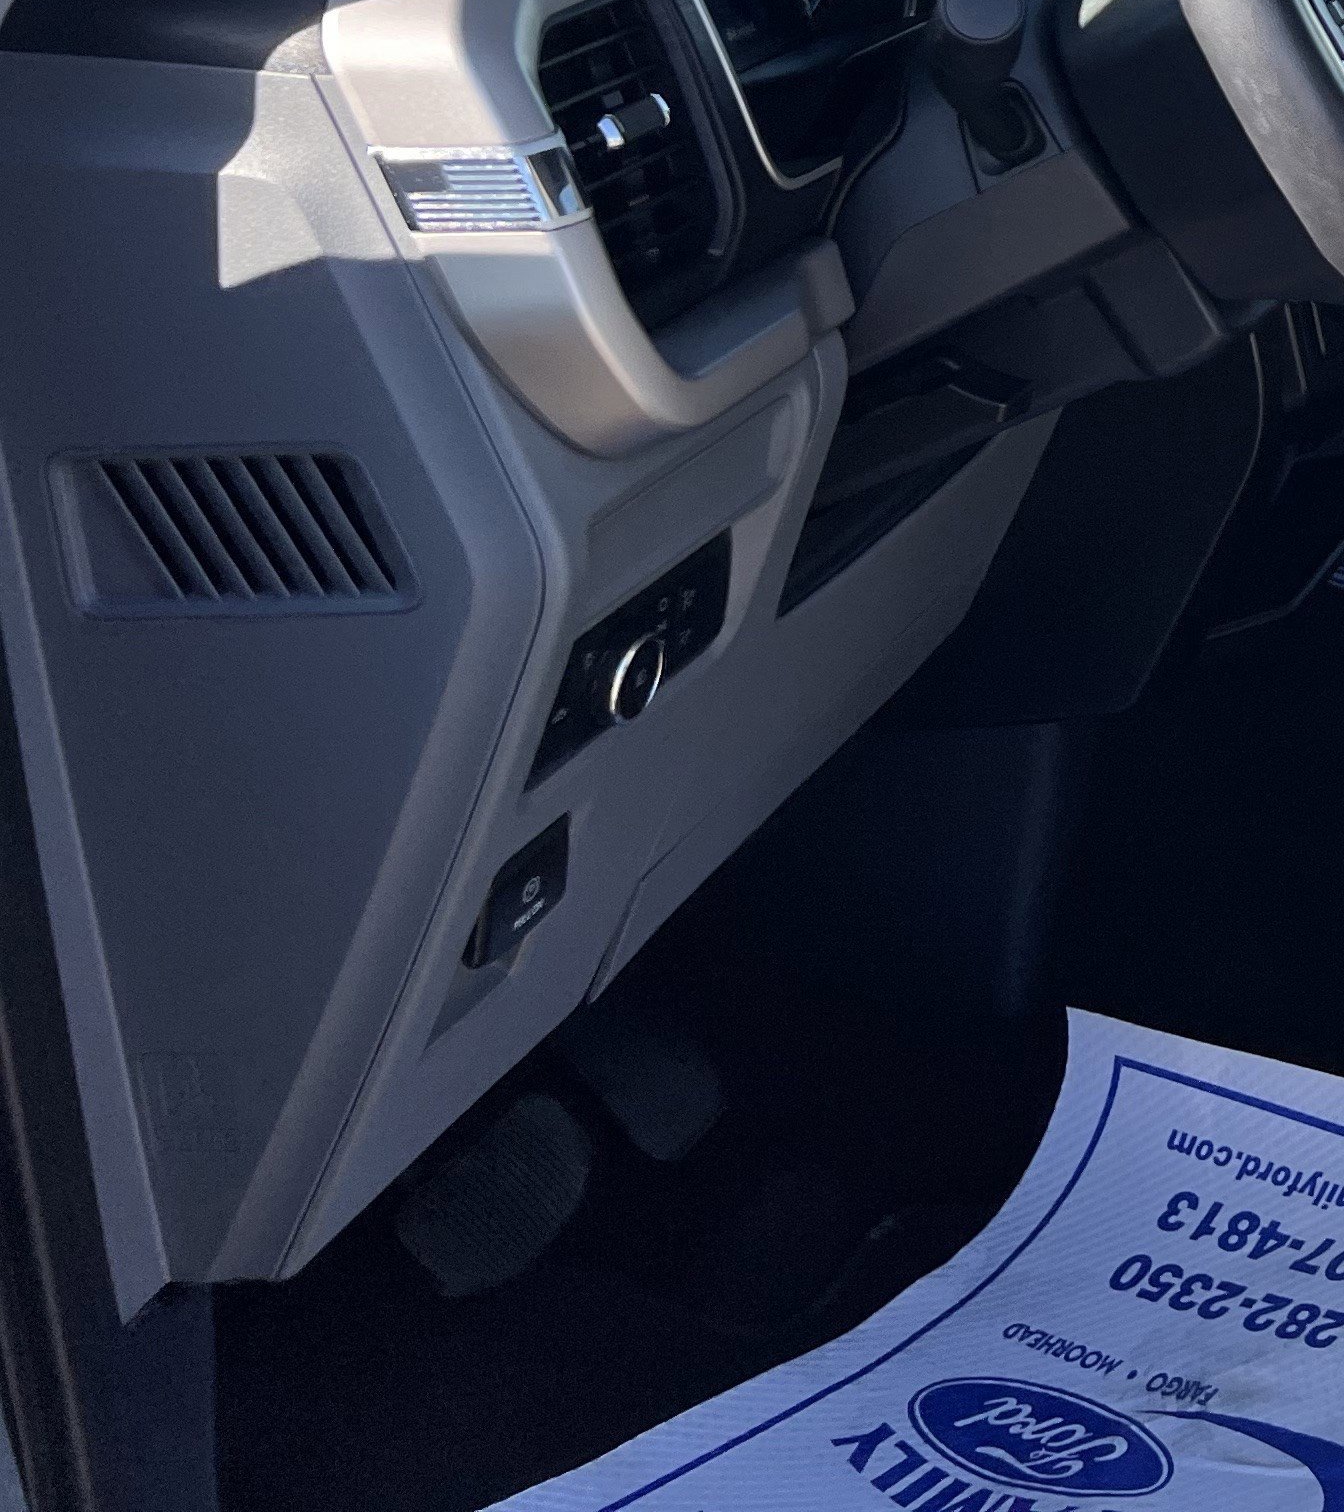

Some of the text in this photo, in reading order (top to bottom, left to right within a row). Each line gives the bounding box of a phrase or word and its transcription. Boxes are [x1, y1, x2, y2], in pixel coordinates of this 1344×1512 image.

[1002, 1322, 1219, 1406] FARGO MOORHEAD
[953, 1397, 1128, 1479] Ford
